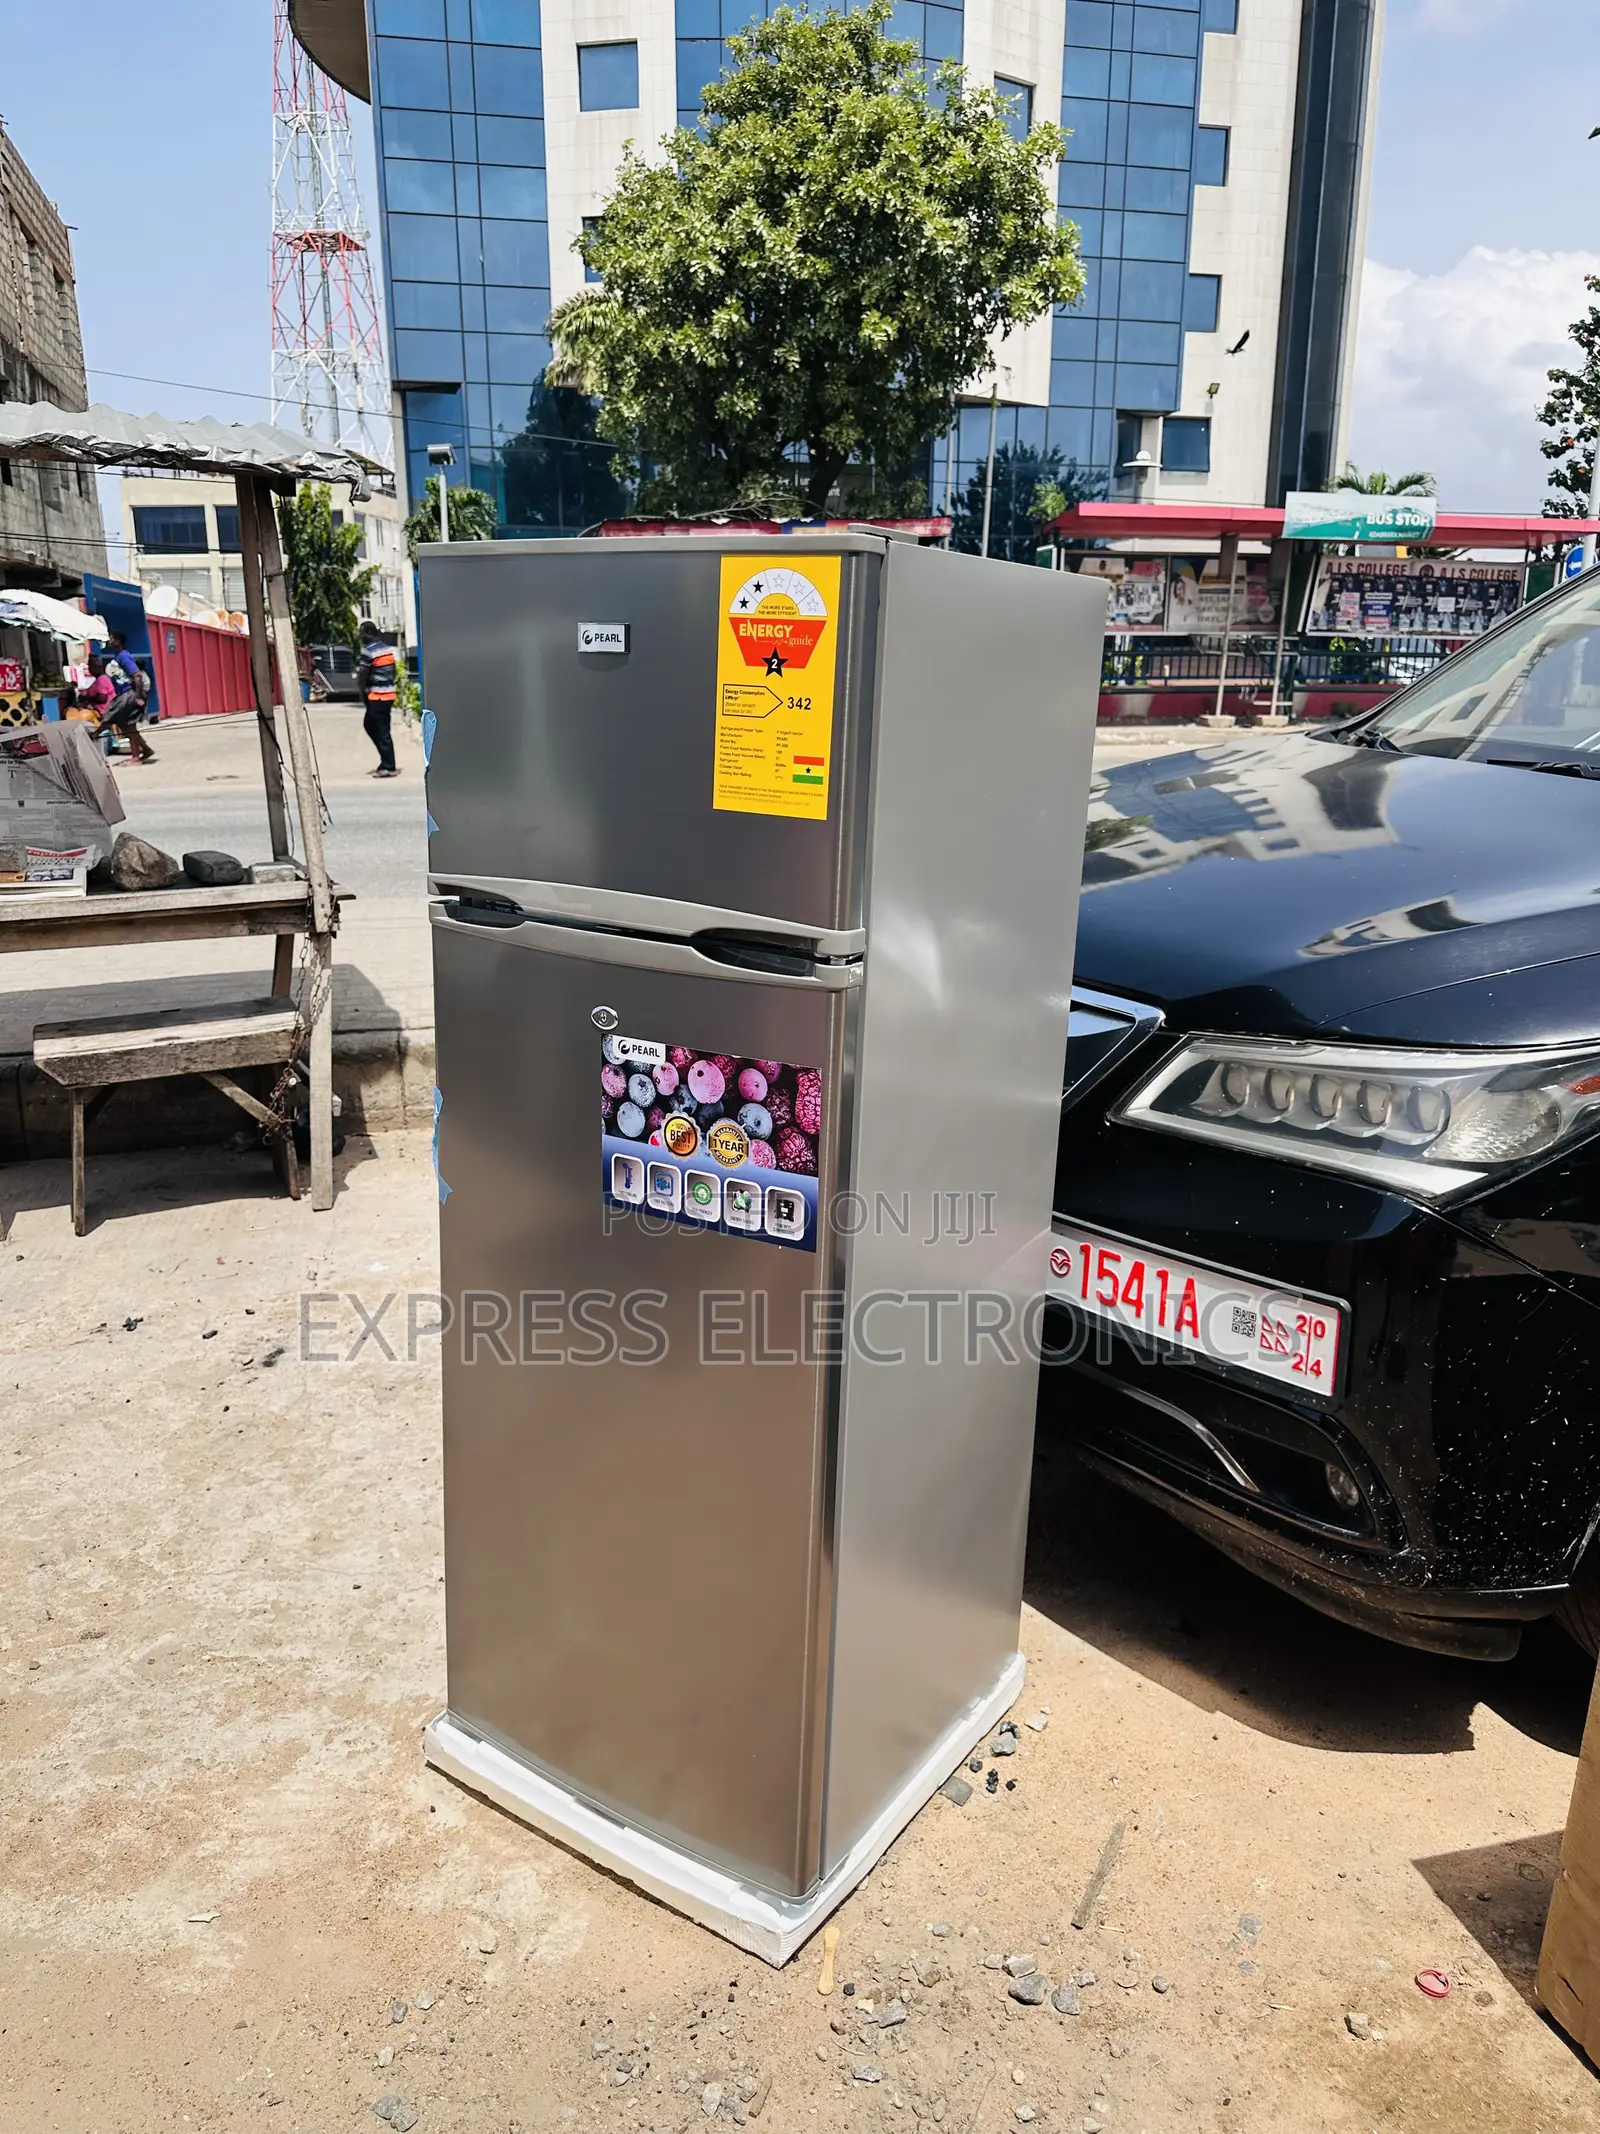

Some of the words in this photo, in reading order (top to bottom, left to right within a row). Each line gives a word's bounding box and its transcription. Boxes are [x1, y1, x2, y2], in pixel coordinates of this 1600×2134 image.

[1366, 512, 1393, 526] BUS
[1395, 512, 1431, 528] STOP
[1356, 563, 1408, 577] COLLEGE
[1470, 568, 1518, 581] COLLEGE
[594, 633, 622, 642] PEARL
[739, 620, 794, 641] ENERGY
[788, 635, 814, 647] guide
[771, 658, 778, 669] 2
[787, 696, 812, 710] 342
[631, 1044, 660, 1058] PEARL
[670, 1129, 693, 1144] BEST
[715, 1127, 742, 1142] WARRANTY
[719, 1139, 744, 1153] YEAR
[1079, 1243, 1200, 1339] 1541A
